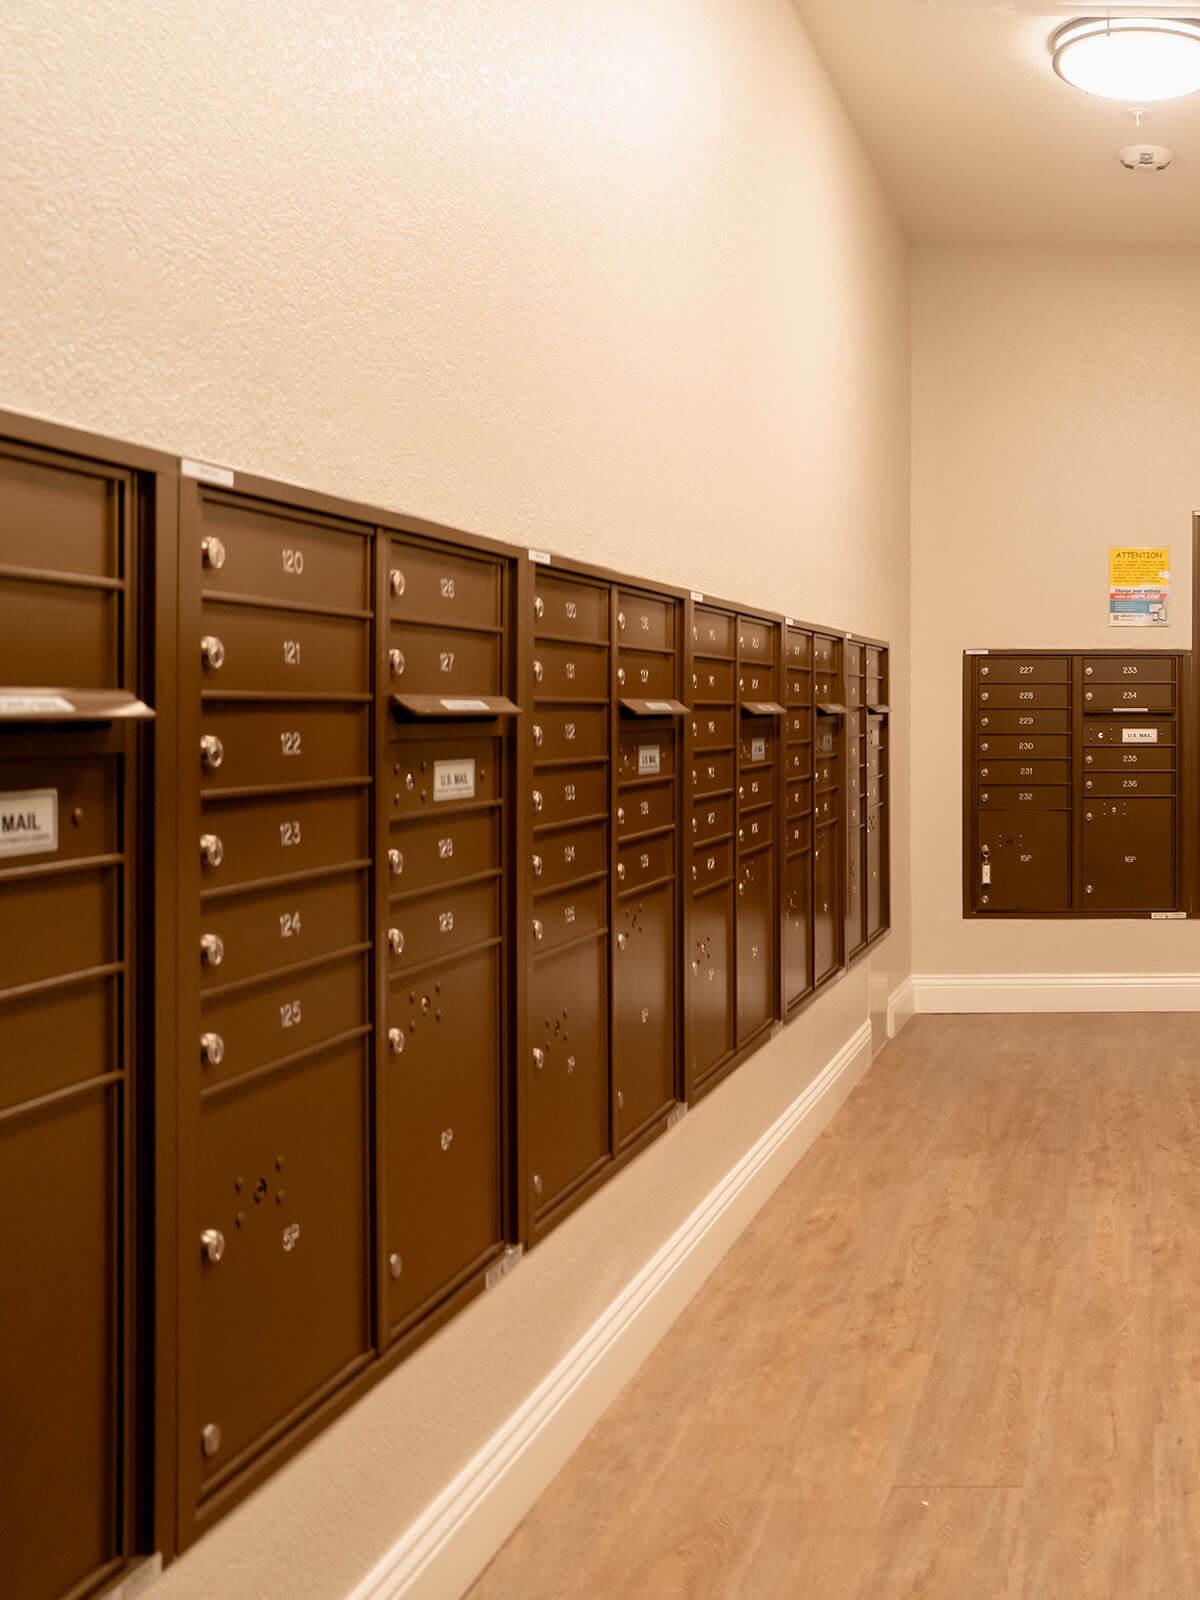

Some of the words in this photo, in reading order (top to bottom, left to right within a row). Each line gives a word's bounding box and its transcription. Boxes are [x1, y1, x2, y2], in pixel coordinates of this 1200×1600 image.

[1115, 551, 1163, 559] ATTENTION
[281, 548, 304, 575] 120
[282, 640, 301, 665] 121
[439, 652, 455, 673] 127
[1019, 665, 1034, 674] 227
[1122, 666, 1138, 674] 233
[1018, 691, 1034, 700] 228
[1122, 691, 1138, 700] 234
[1018, 716, 1034, 726] 229
[280, 731, 302, 756] 122
[1018, 741, 1034, 751] 230
[1122, 754, 1138, 763] 235
[1019, 767, 1033, 776] 231
[454, 773, 468, 785] MAIL
[1122, 779, 1138, 788] 236
[1018, 792, 1033, 801] 232
[1, 813, 41, 832] MAIL
[279, 821, 302, 846] 123
[279, 911, 302, 938] 124
[279, 999, 302, 1028] 125
[282, 1223, 300, 1252] 5P
